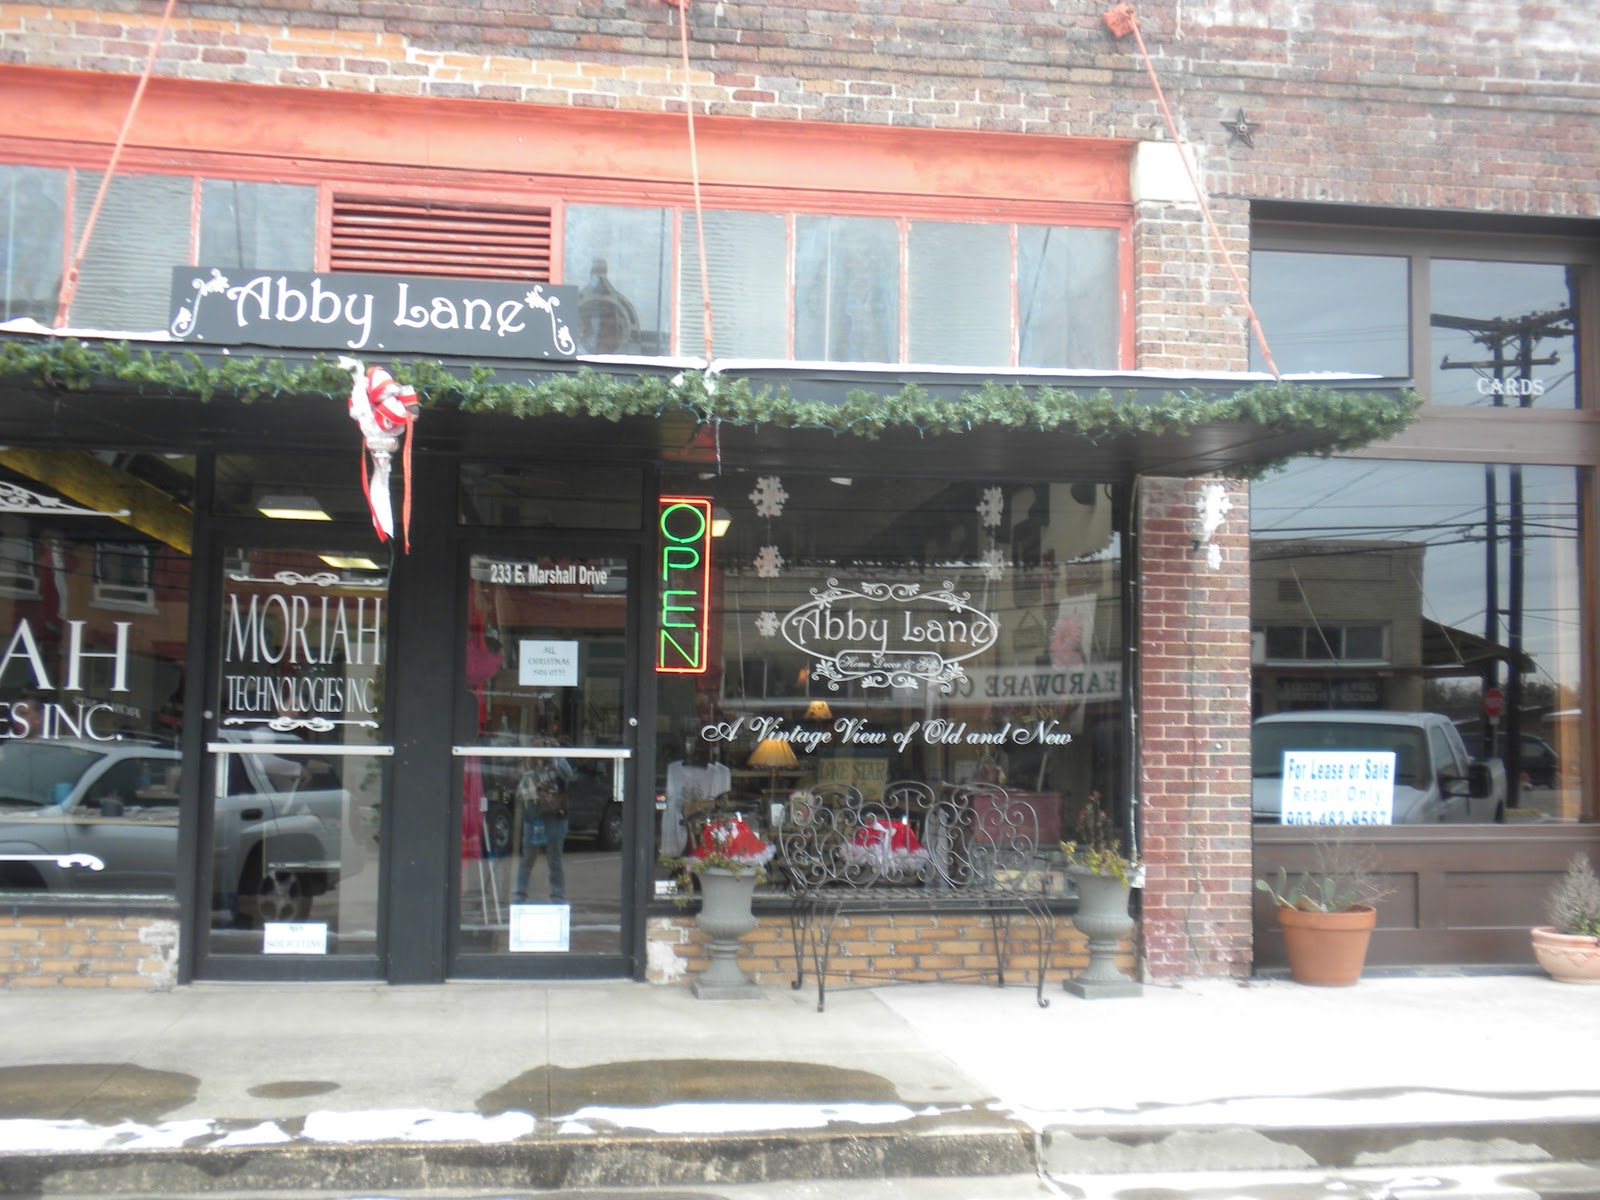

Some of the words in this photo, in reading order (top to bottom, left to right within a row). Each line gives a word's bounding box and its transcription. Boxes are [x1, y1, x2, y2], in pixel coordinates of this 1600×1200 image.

[227, 276, 374, 349] Abby
[393, 283, 526, 336] Lane
[1477, 378, 1545, 396] CARDS
[490, 564, 511, 583] 233
[528, 565, 576, 584] Marshall
[579, 565, 608, 585] Drive
[660, 503, 706, 668] OPEN
[225, 593, 382, 665] MORIAH
[792, 609, 888, 658] Abby
[902, 610, 991, 647] Lane
[225, 675, 343, 713] TECHNOLOGIES
[346, 678, 378, 713] INC.
[41, 703, 123, 741] INC.
[701, 716, 745, 742] A
[750, 716, 833, 754] Vintage
[834, 717, 888, 744] View
[893, 721, 921, 753] of
[922, 718, 967, 745] Old
[966, 722, 1011, 745] and
[1012, 720, 1072, 745] New
[1289, 758, 1307, 780] For
[1311, 759, 1344, 780] Lease
[1349, 764, 1361, 780] or
[1364, 759, 1390, 780] Sale
[1293, 786, 1340, 802] Retail
[1347, 786, 1382, 806] Only
